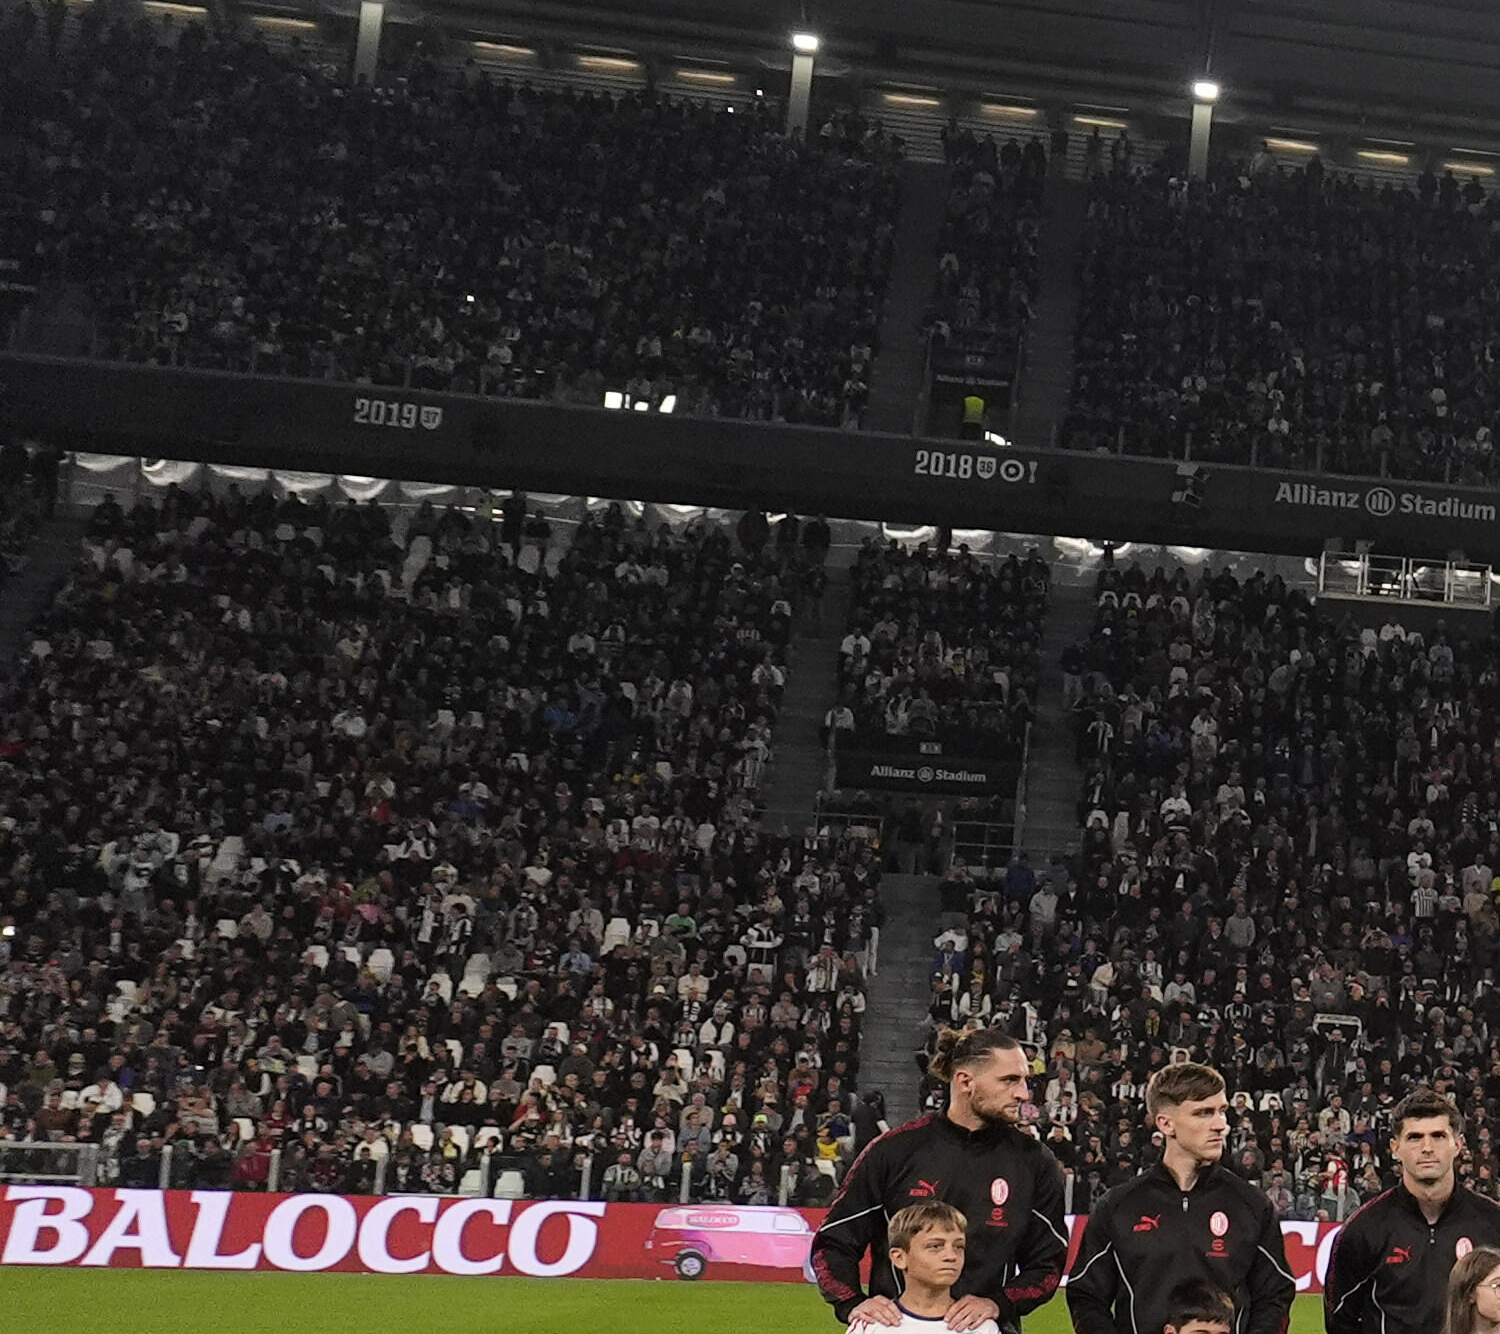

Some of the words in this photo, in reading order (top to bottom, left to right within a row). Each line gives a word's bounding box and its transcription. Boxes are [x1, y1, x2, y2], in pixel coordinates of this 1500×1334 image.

[353, 398, 418, 428] 2019
[914, 449, 973, 480] 2018
[979, 460, 993, 473] 36
[1275, 482, 1360, 509] Allianz
[1399, 492, 1497, 521] Stadium
[870, 764, 915, 780] Allianz
[935, 768, 987, 783] Stadium
[2, 1185, 607, 1277] BALOCCO
